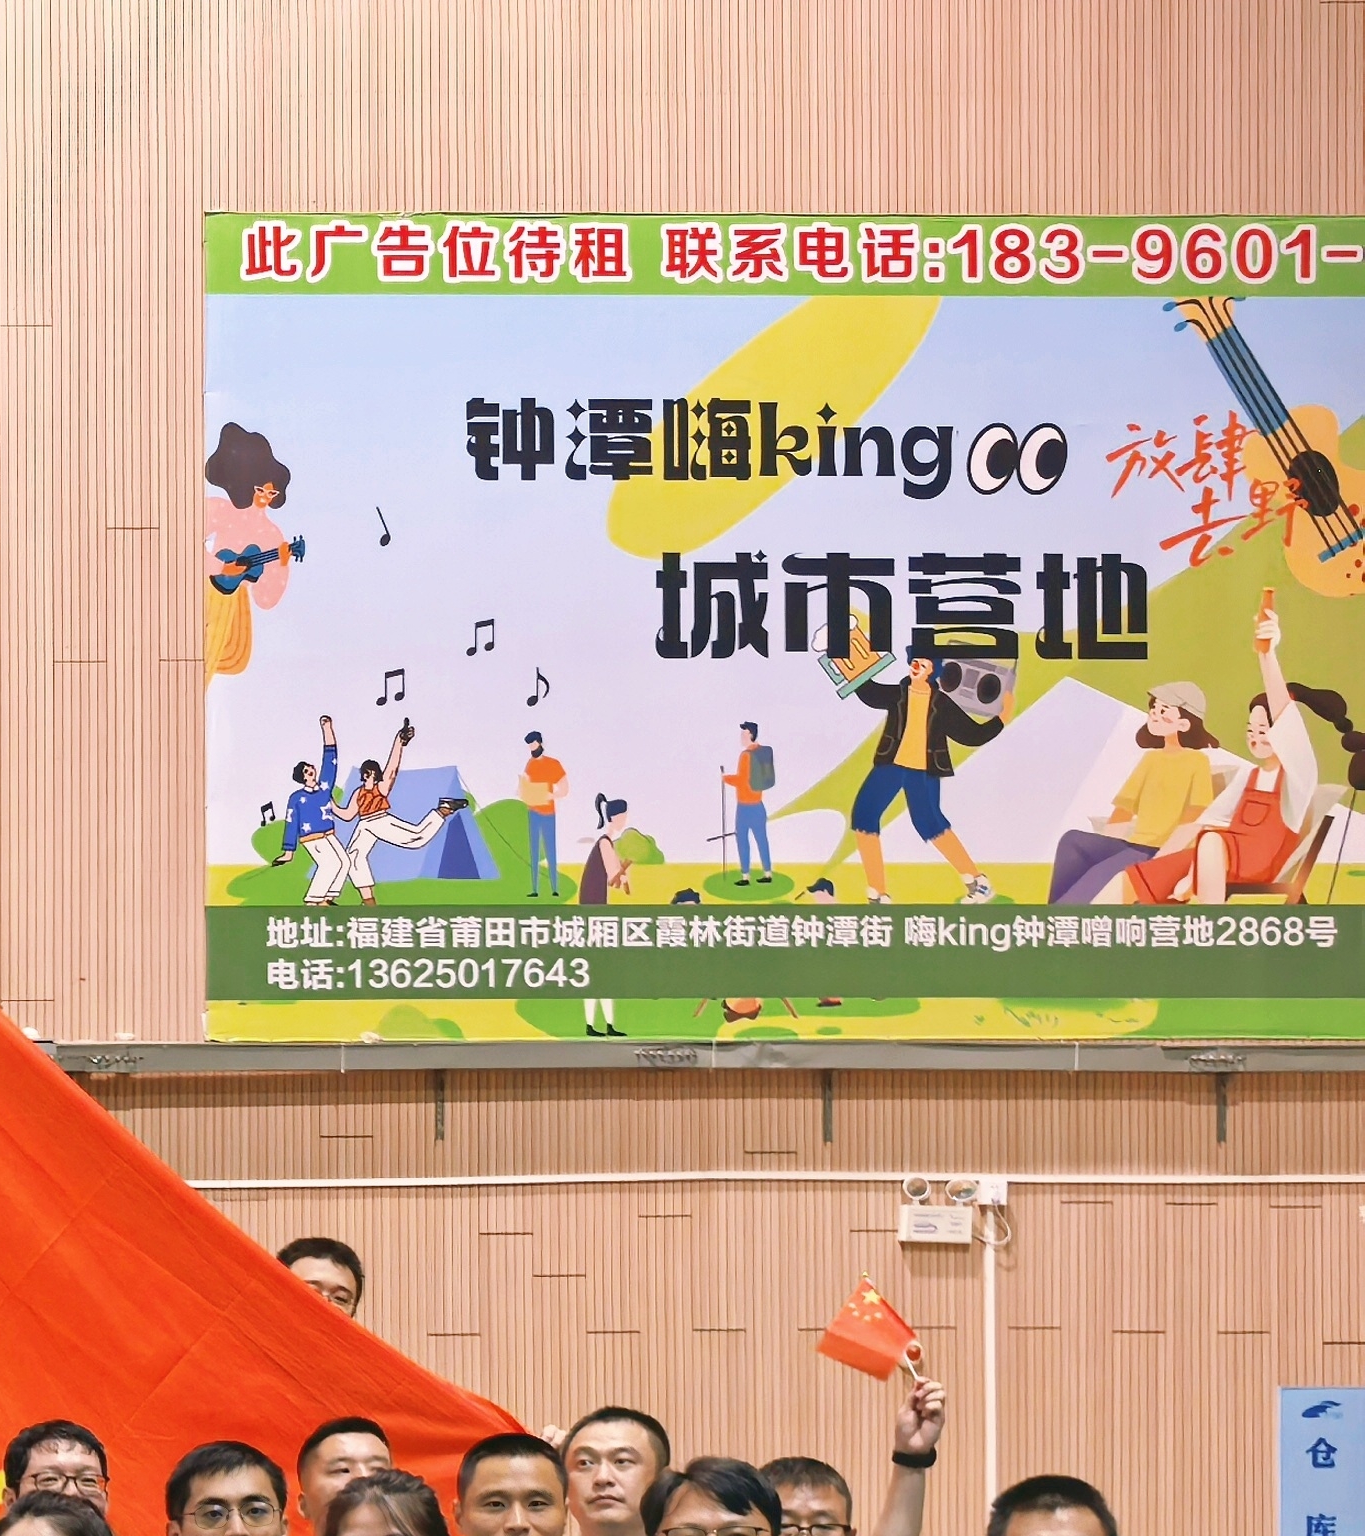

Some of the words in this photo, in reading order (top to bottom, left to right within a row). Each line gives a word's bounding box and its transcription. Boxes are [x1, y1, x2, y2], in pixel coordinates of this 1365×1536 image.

[243, 223, 629, 282] 此广告位待租
[465, 396, 955, 500] 钟潭嗨king
[655, 549, 1150, 660] 城市营地
[266, 957, 591, 991] 电话:13625017643
